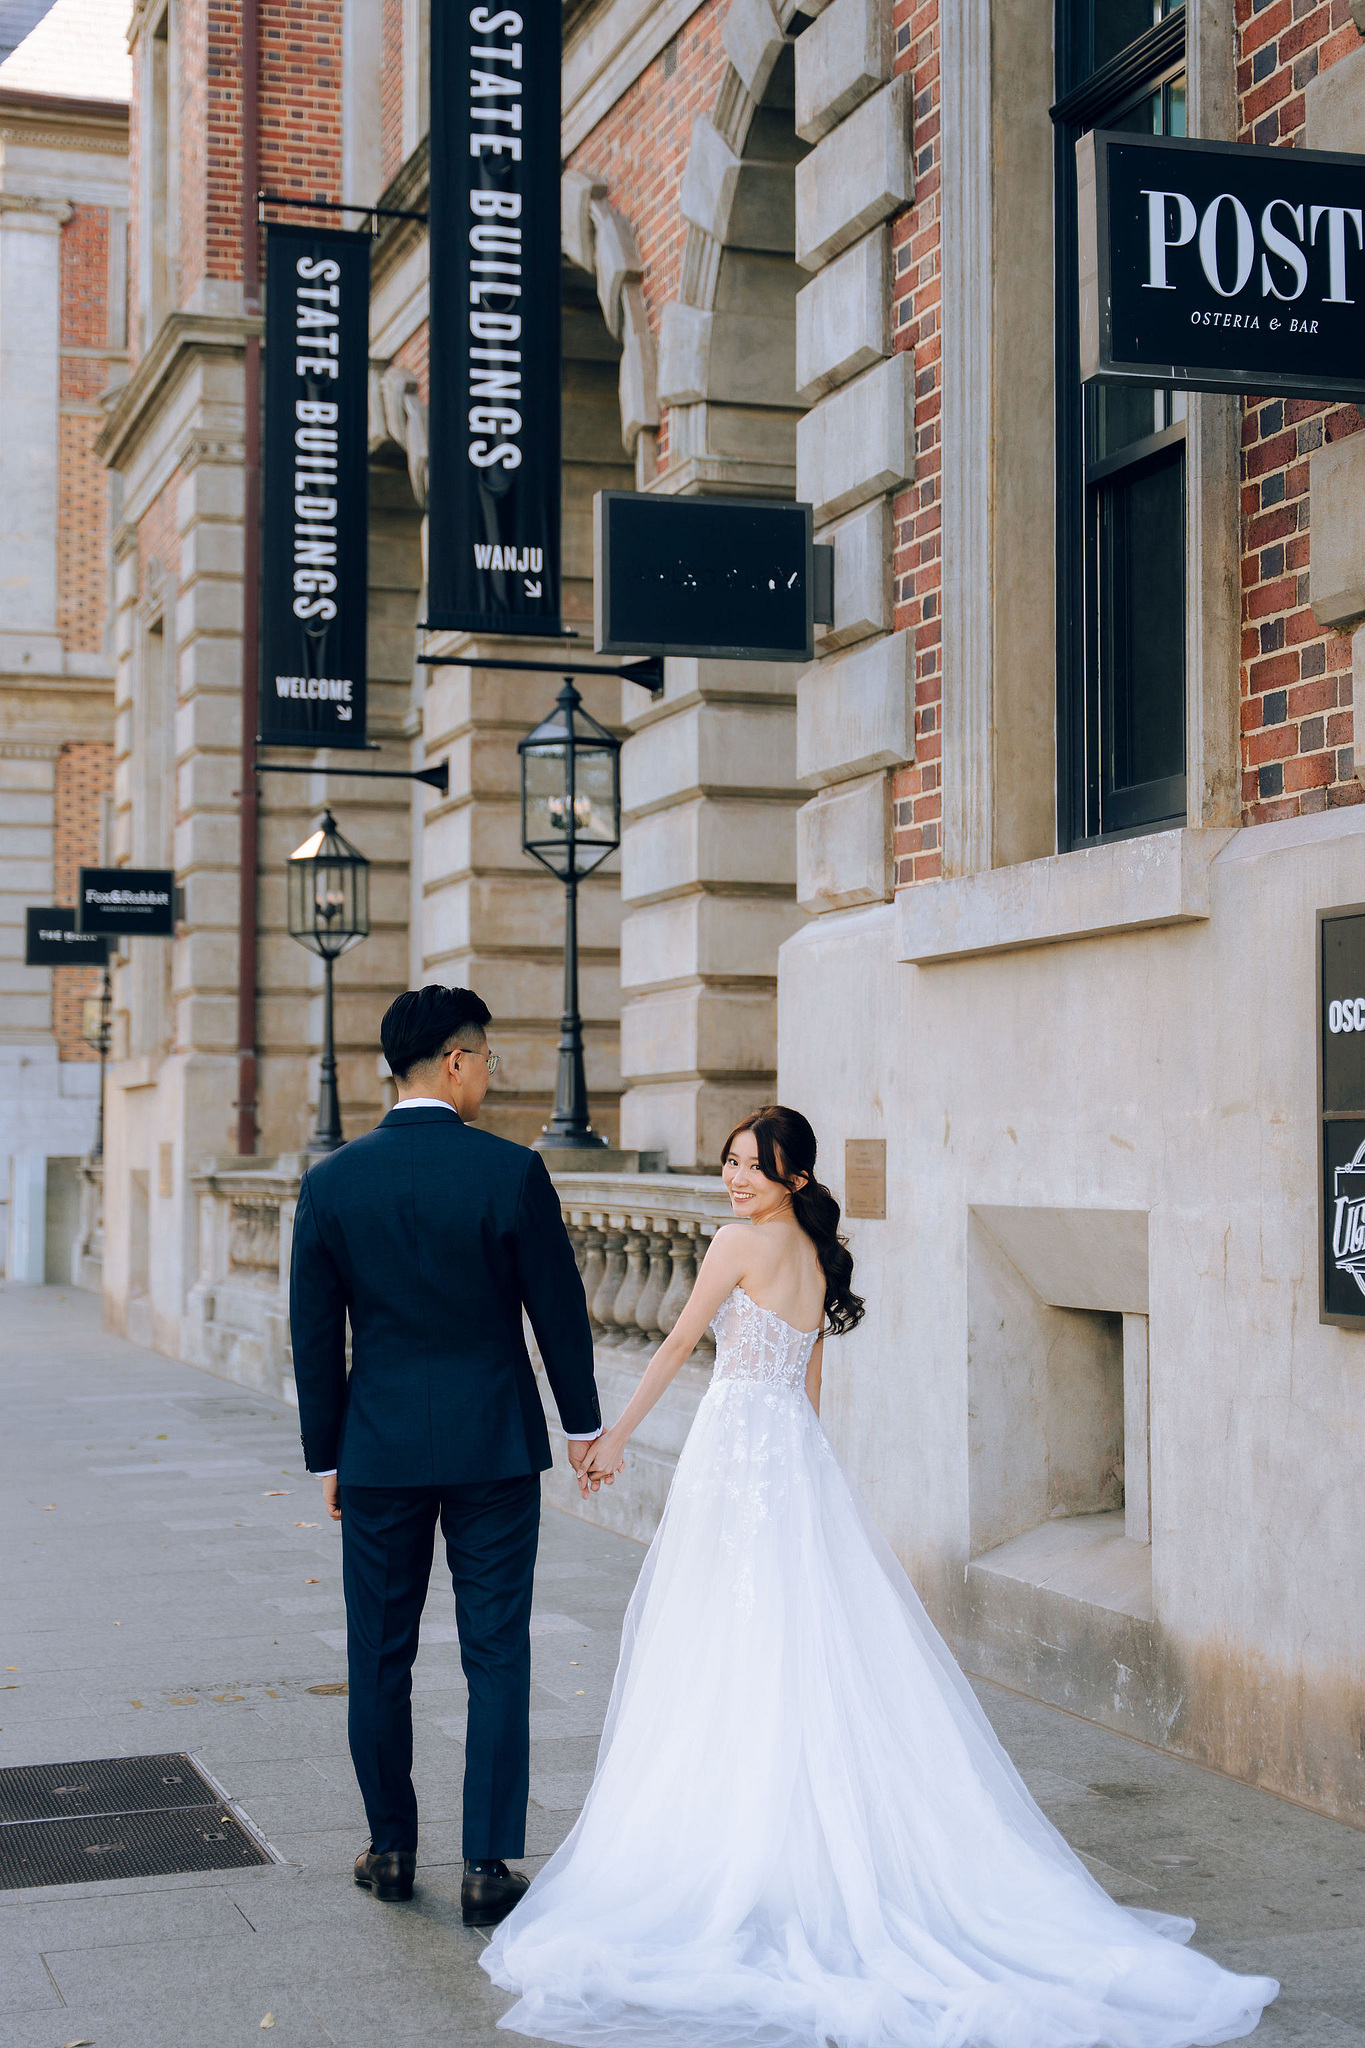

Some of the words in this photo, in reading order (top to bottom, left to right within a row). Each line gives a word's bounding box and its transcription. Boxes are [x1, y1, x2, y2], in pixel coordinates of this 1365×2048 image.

[469, 6, 524, 161] STATE
[1139, 189, 1365, 304] POST
[296, 256, 341, 379] STATE
[468, 189, 523, 470] BUILDINGS
[1190, 311, 1260, 329] OSTERIA
[1269, 317, 1282, 331] &
[1289, 318, 1319, 334] BAR
[292, 399, 339, 620] BUILDINGS
[473, 543, 543, 573] WANJU
[275, 676, 353, 702] WELCOME
[1328, 997, 1365, 1034] OSC
[1332, 1196, 1365, 1259] UG
[128, 1689, 281, 1710] 1861
